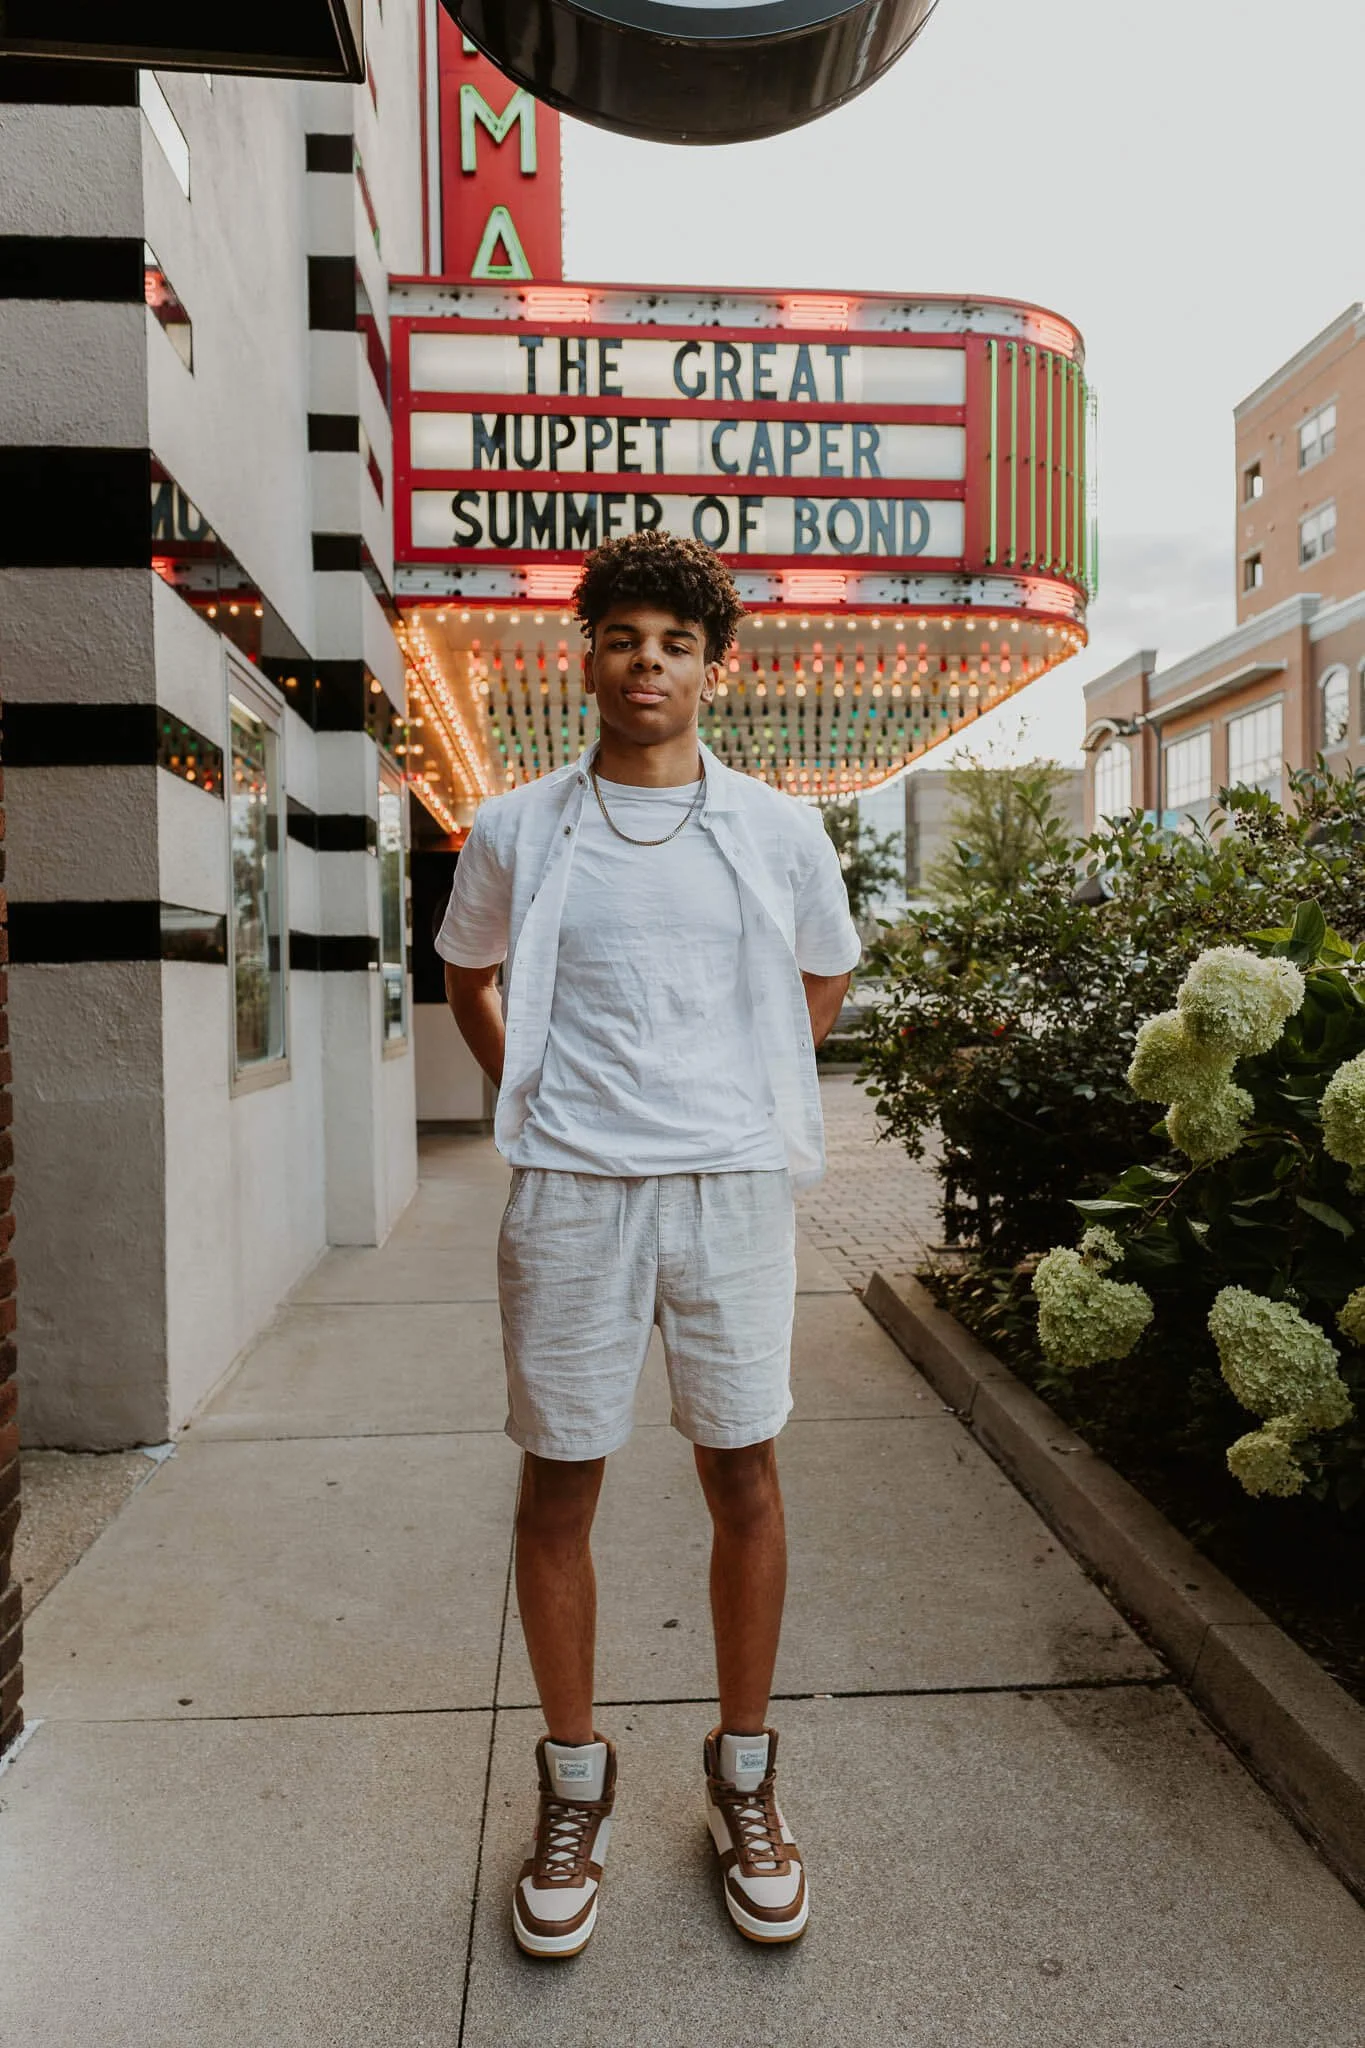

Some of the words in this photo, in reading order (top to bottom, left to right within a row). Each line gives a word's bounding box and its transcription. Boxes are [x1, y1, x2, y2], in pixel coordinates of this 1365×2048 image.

[519, 335, 623, 396] THE
[673, 340, 850, 402] GREAT
[472, 413, 671, 474] MUPPET
[711, 419, 882, 478] CAPER
[452, 490, 663, 550] SUMMER
[692, 495, 763, 554] OF
[794, 497, 930, 557] BOND
